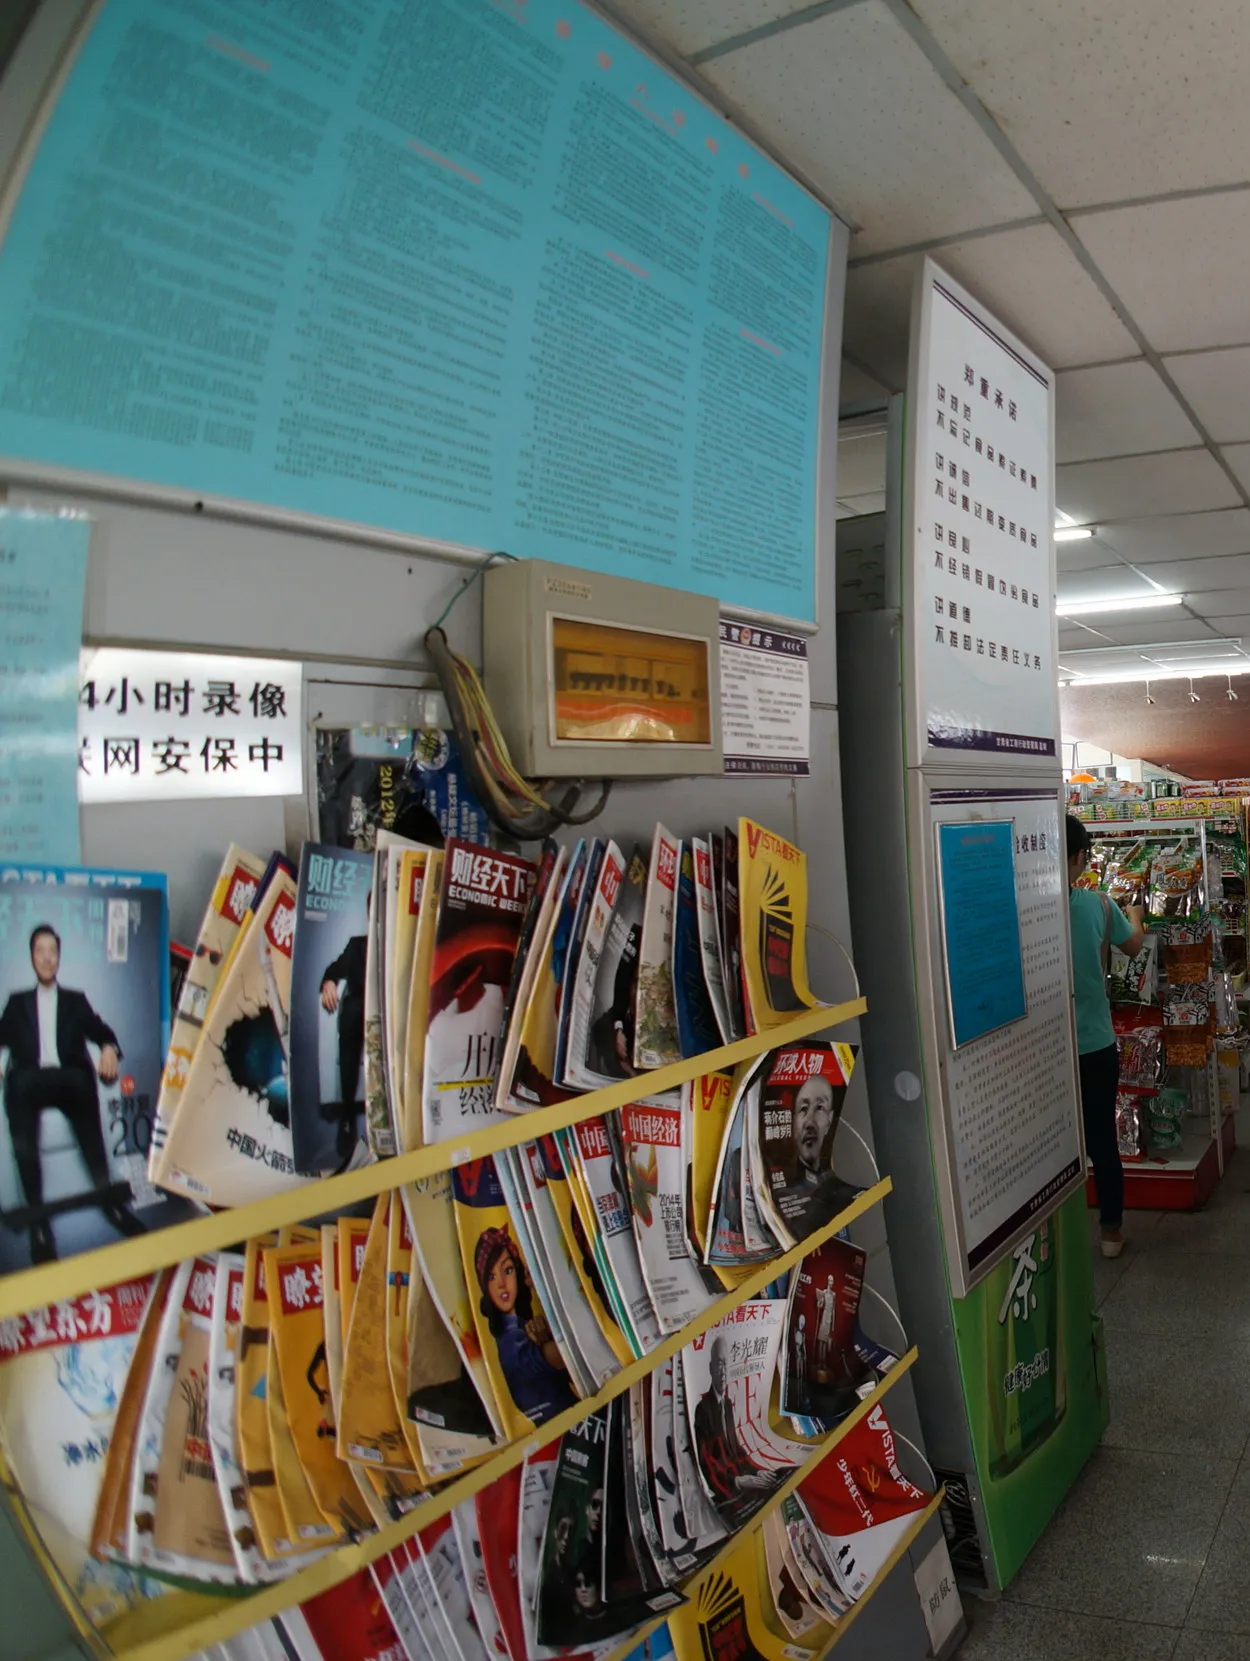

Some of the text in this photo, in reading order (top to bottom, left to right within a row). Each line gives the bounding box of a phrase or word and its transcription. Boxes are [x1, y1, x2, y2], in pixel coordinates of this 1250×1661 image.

[964, 364, 1018, 421] 郑重承诺
[450, 848, 529, 898] 财经天下
[449, 885, 498, 909] ECONOMIC
[774, 1054, 824, 1075] 环球人物
[629, 1111, 680, 1145] 中国经济
[729, 1336, 770, 1363] 李光耀
[837, 1458, 875, 1527] 少年红二代
